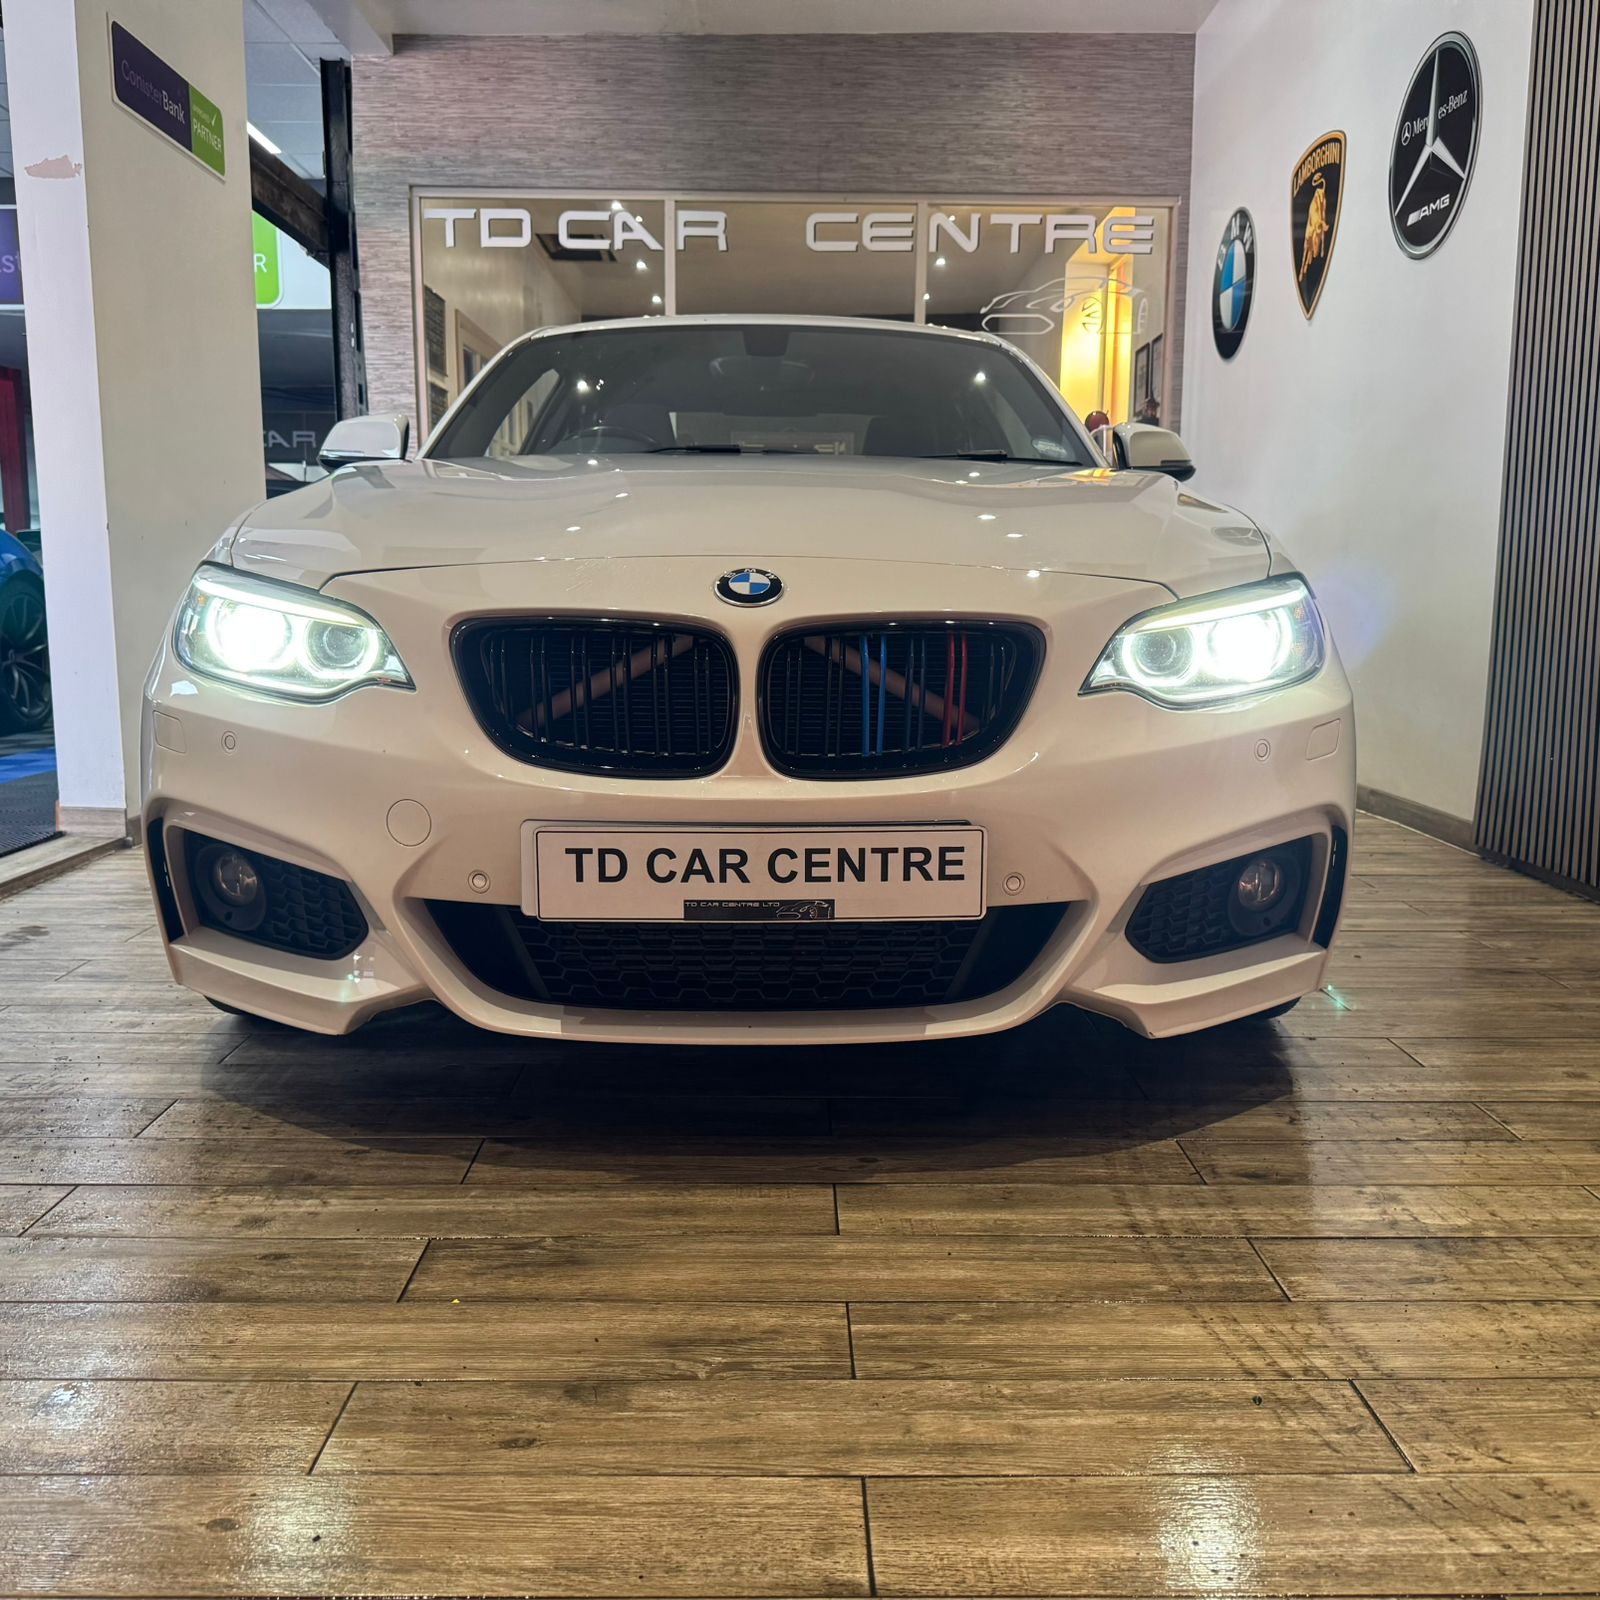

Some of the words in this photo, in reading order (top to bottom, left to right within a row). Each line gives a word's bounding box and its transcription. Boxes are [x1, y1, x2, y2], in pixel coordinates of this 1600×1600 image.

[193, 118, 222, 152] PARTNER
[1294, 142, 1340, 197] LAMBORGHINI
[1418, 193, 1450, 221] AMG
[424, 208, 532, 248] TD
[558, 210, 728, 251] CAR
[806, 212, 1154, 255] CENTRE
[565, 847, 629, 883] TD
[646, 847, 751, 884] CAR
[767, 846, 966, 884] CENTRE
